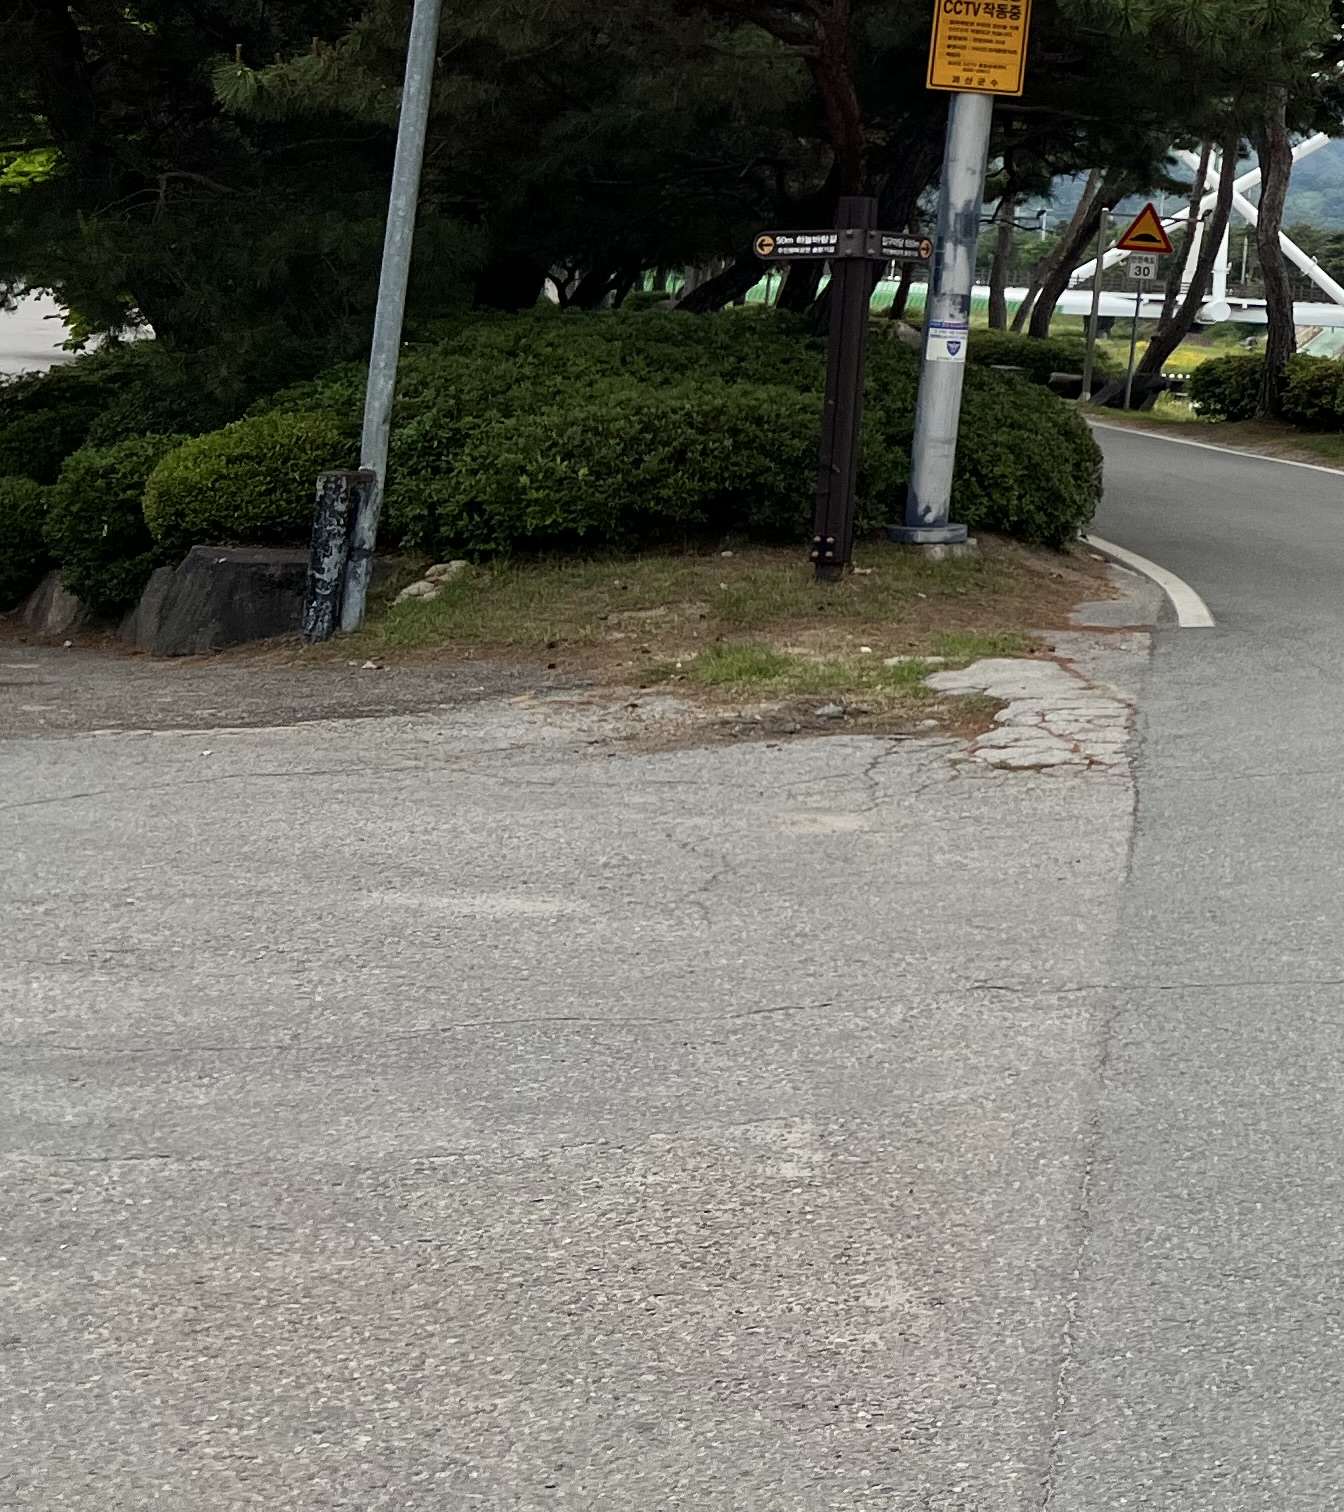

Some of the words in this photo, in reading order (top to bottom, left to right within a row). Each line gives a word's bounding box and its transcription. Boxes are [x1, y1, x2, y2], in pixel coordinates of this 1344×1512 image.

[943, 0, 982, 17] CCTV
[983, 2, 1022, 20] 작동중
[1134, 265, 1151, 277] 30
